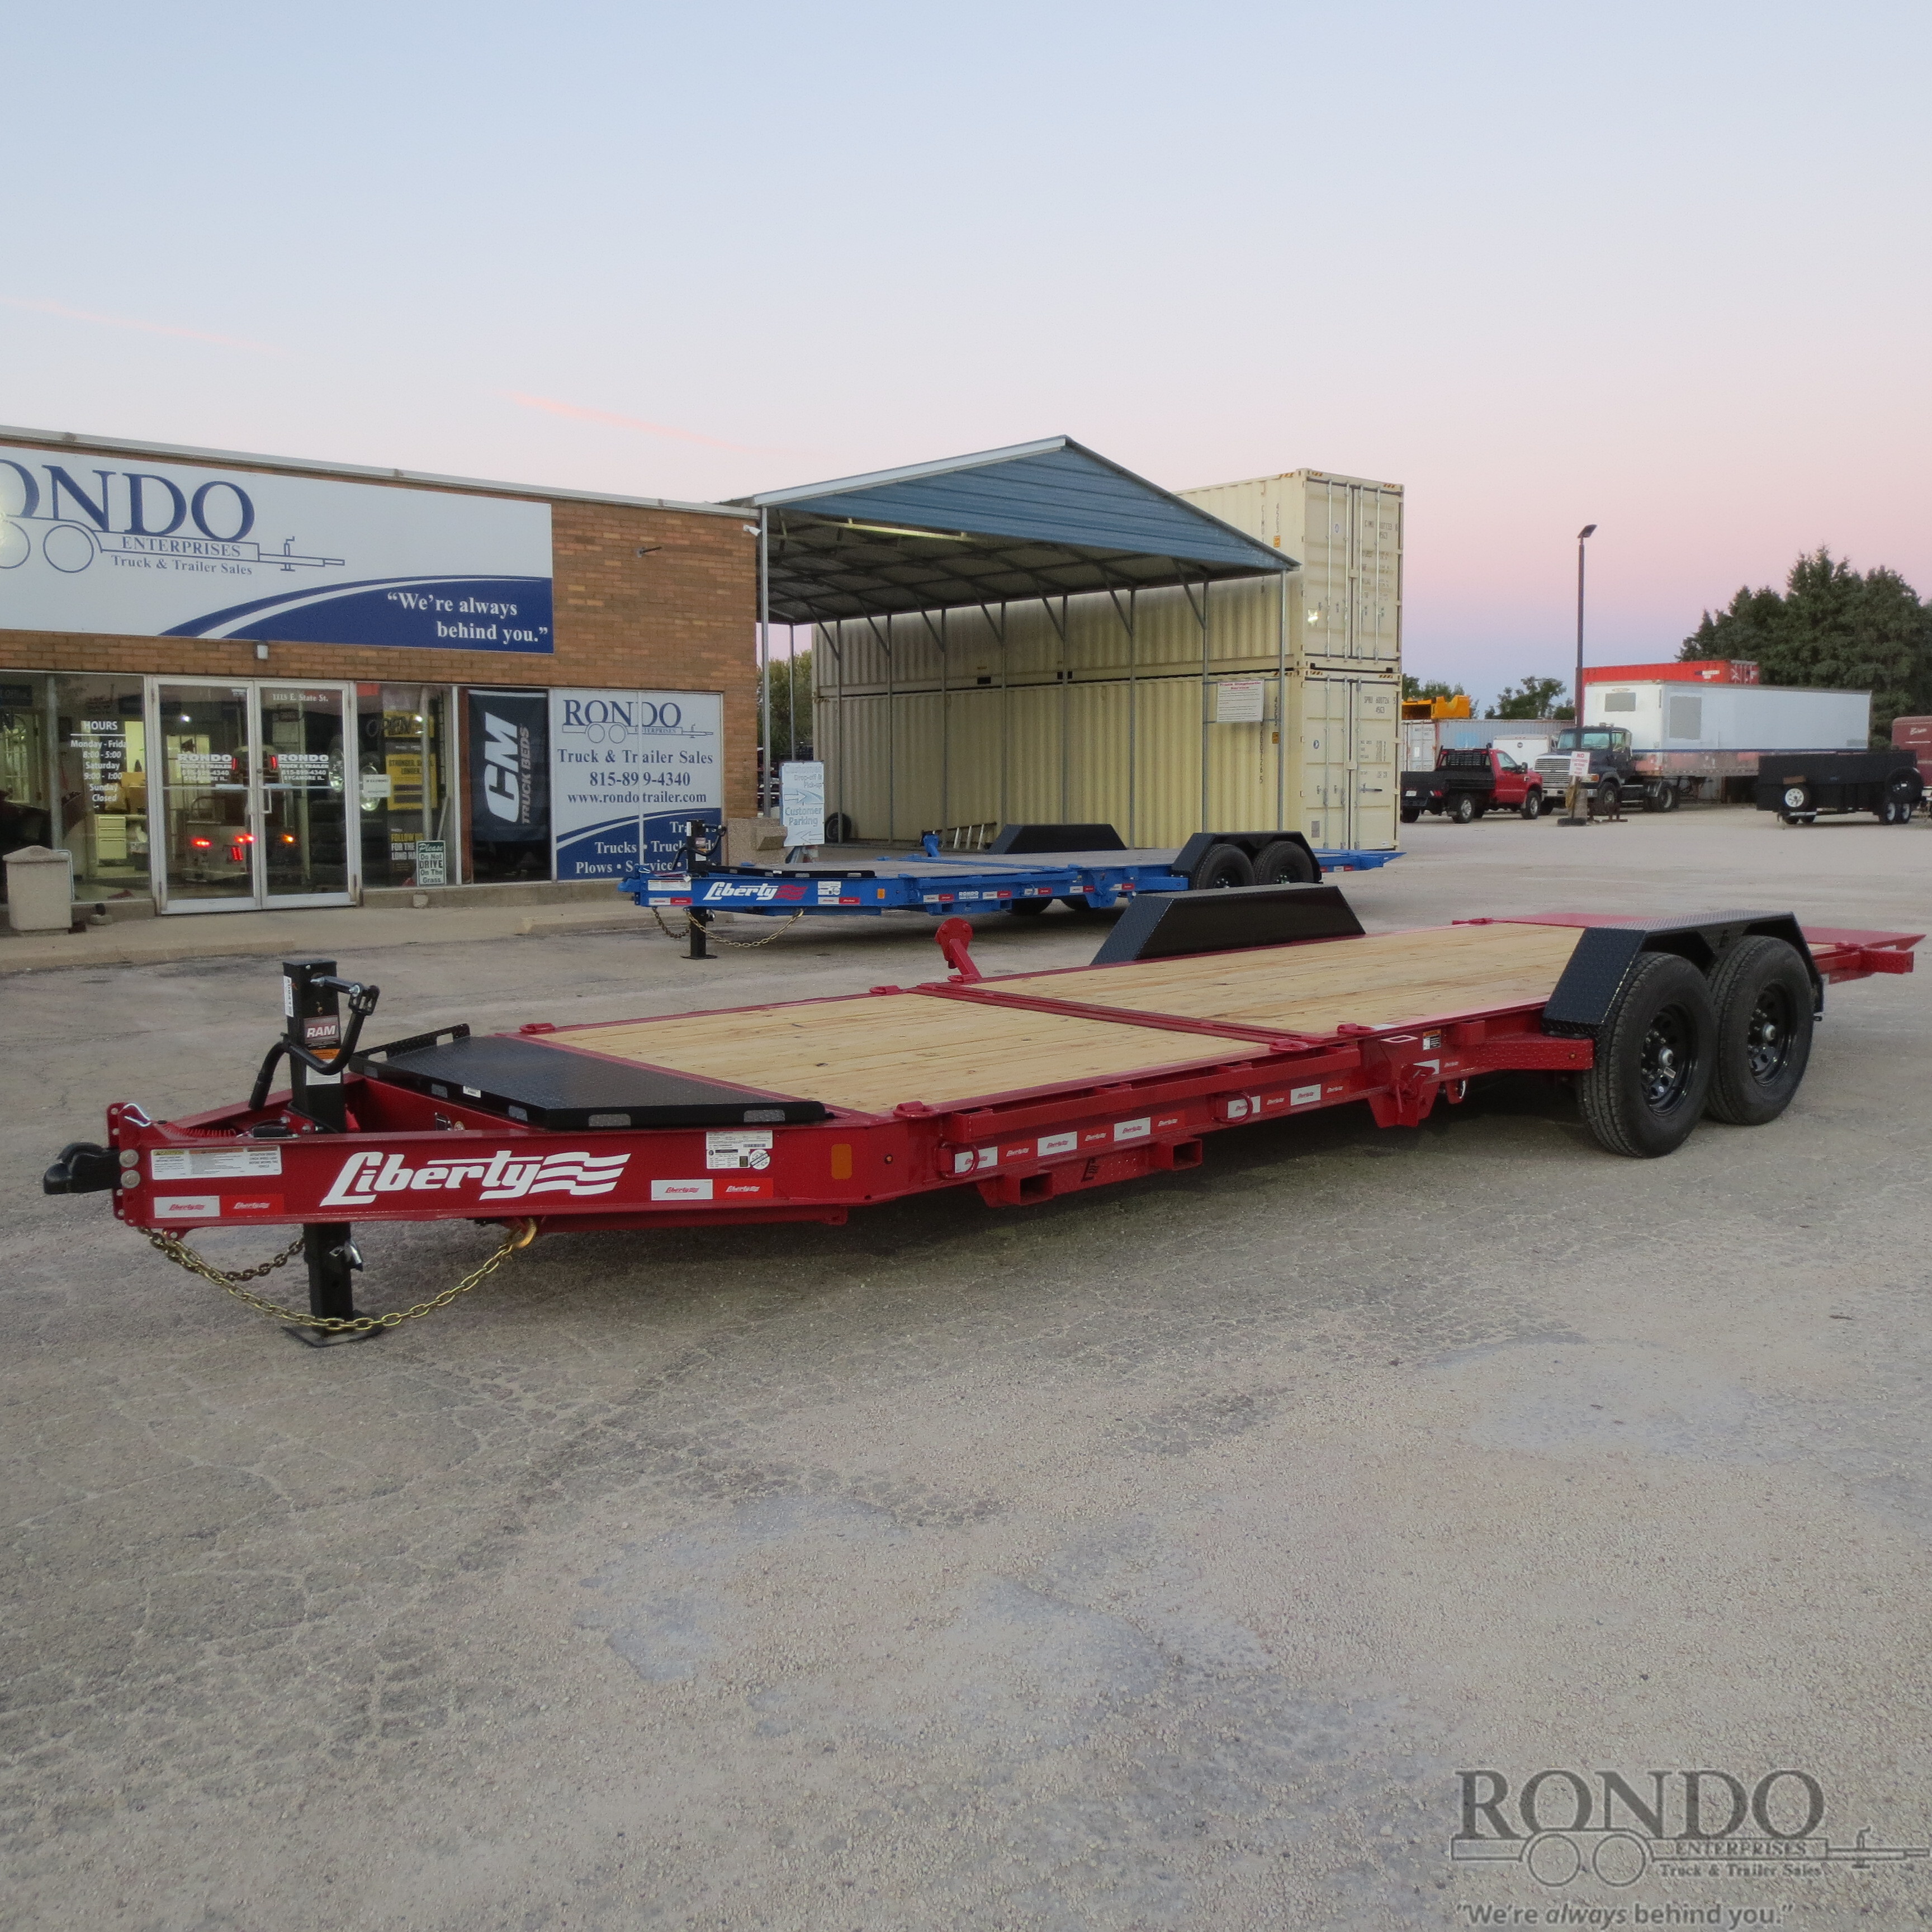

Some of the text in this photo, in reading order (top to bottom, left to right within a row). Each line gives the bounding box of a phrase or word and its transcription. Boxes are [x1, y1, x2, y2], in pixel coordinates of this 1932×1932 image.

[122, 536, 240, 557] ENTERPRISES
[111, 555, 252, 575] Truck & Trailer Sales
[460, 597, 517, 619] always
[437, 621, 496, 640] behind
[563, 699, 681, 727] RONDO
[84, 721, 118, 731] HOURS
[70, 740, 102, 749] Monday
[108, 740, 129, 749] Frida
[278, 753, 329, 761] RONDO
[557, 749, 599, 763] Truck
[605, 750, 615, 763] &
[680, 750, 713, 764] Sales
[86, 761, 120, 770] Saturday
[484, 712, 520, 823] CM
[519, 726, 532, 824] TRUCK BEDS
[590, 771, 691, 787] 815-899-4340
[89, 784, 119, 792] Sunday
[568, 791, 707, 803] www.rondotrailer.com
[785, 807, 822, 816] Customer
[789, 817, 818, 827] Parking
[419, 843, 444, 853] Please
[595, 841, 637, 854] Trucks
[576, 861, 613, 874] Plows
[703, 882, 779, 901] Liberty
[307, 1025, 336, 1038] RAM
[319, 1150, 543, 1208] Liberty
